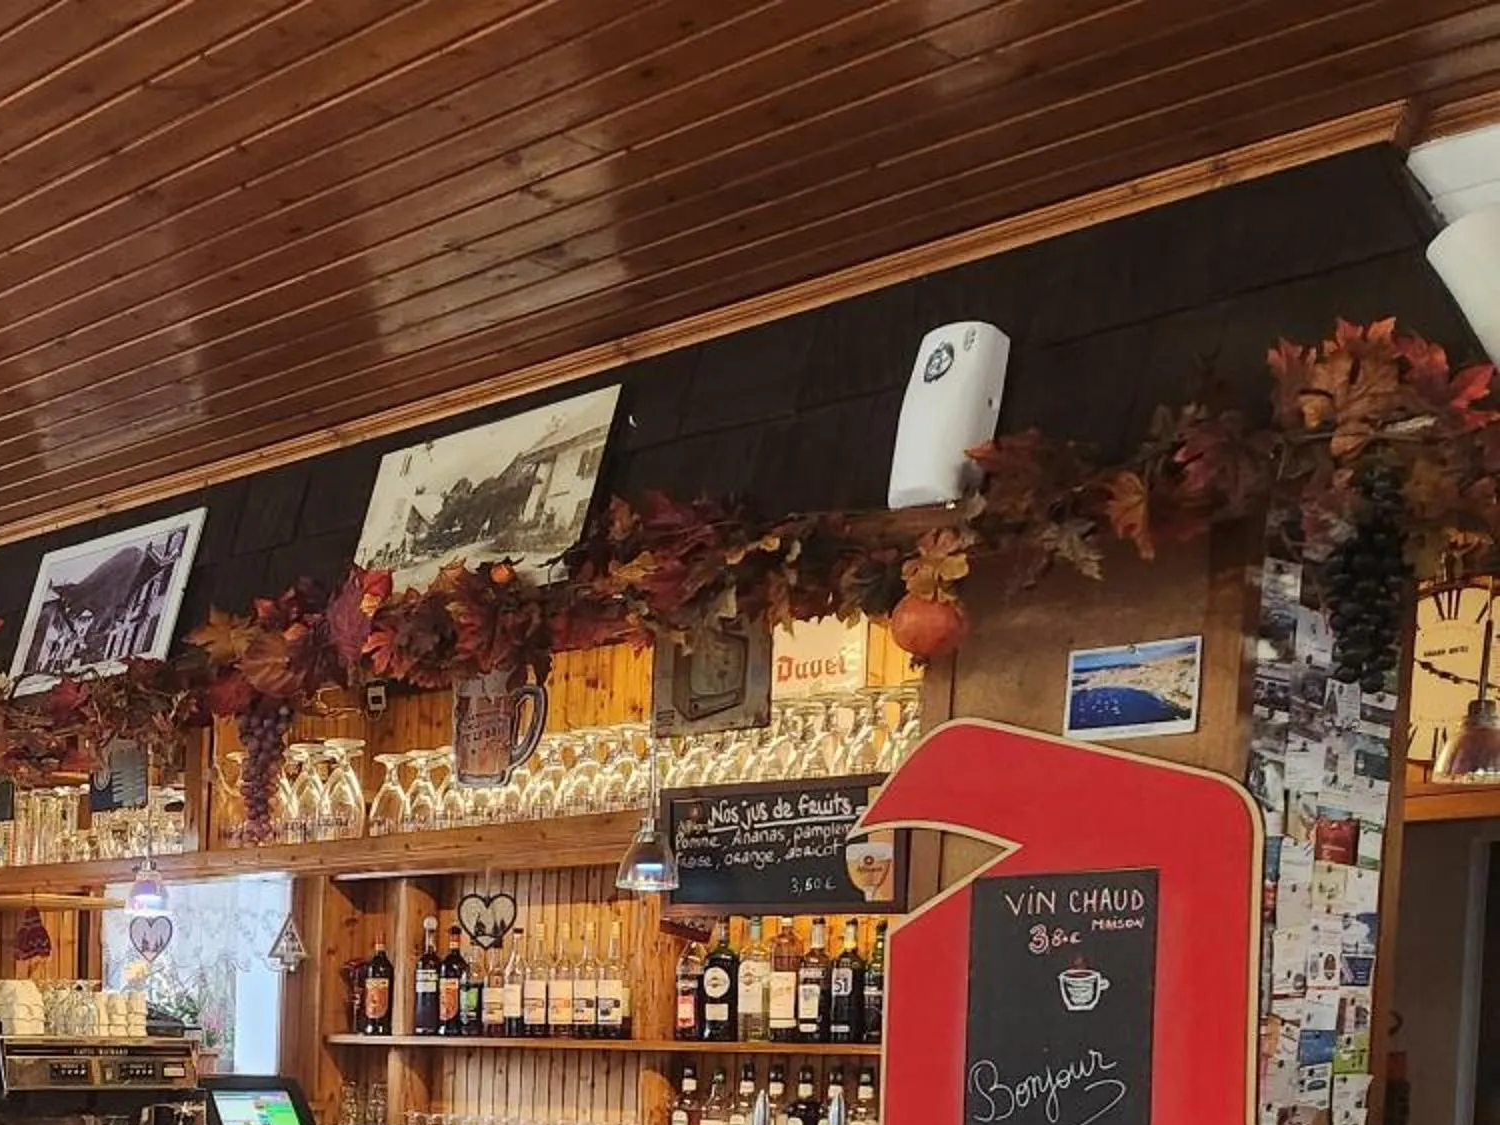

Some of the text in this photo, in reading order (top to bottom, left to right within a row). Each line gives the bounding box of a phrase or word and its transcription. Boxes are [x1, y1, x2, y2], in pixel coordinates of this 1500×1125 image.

[776, 654, 847, 682] Duvel
[708, 791, 852, 830] Nos jus de fruits
[1068, 886, 1146, 914] CHAUD
[833, 978, 851, 995] 51
[967, 1048, 1118, 1124] Bonjour
